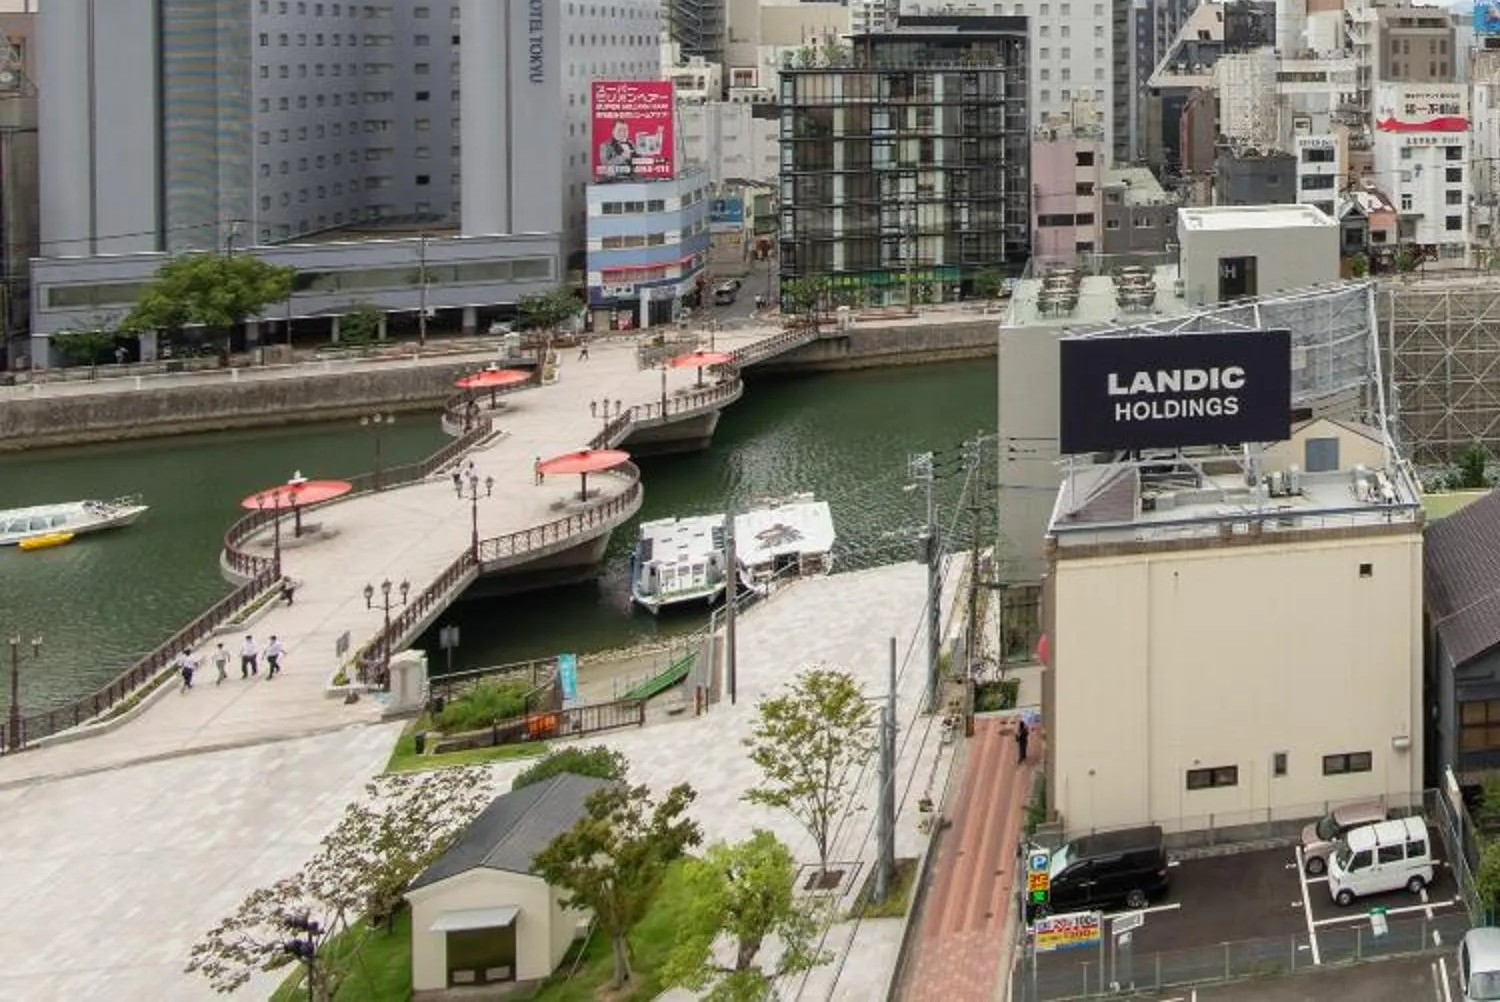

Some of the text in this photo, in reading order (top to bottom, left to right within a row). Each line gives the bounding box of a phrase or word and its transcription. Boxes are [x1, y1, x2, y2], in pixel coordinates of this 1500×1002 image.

[529, 36, 544, 85] TOKYU
[1107, 365, 1246, 396] LANDIC
[1115, 397, 1240, 422] HOLDINGS
